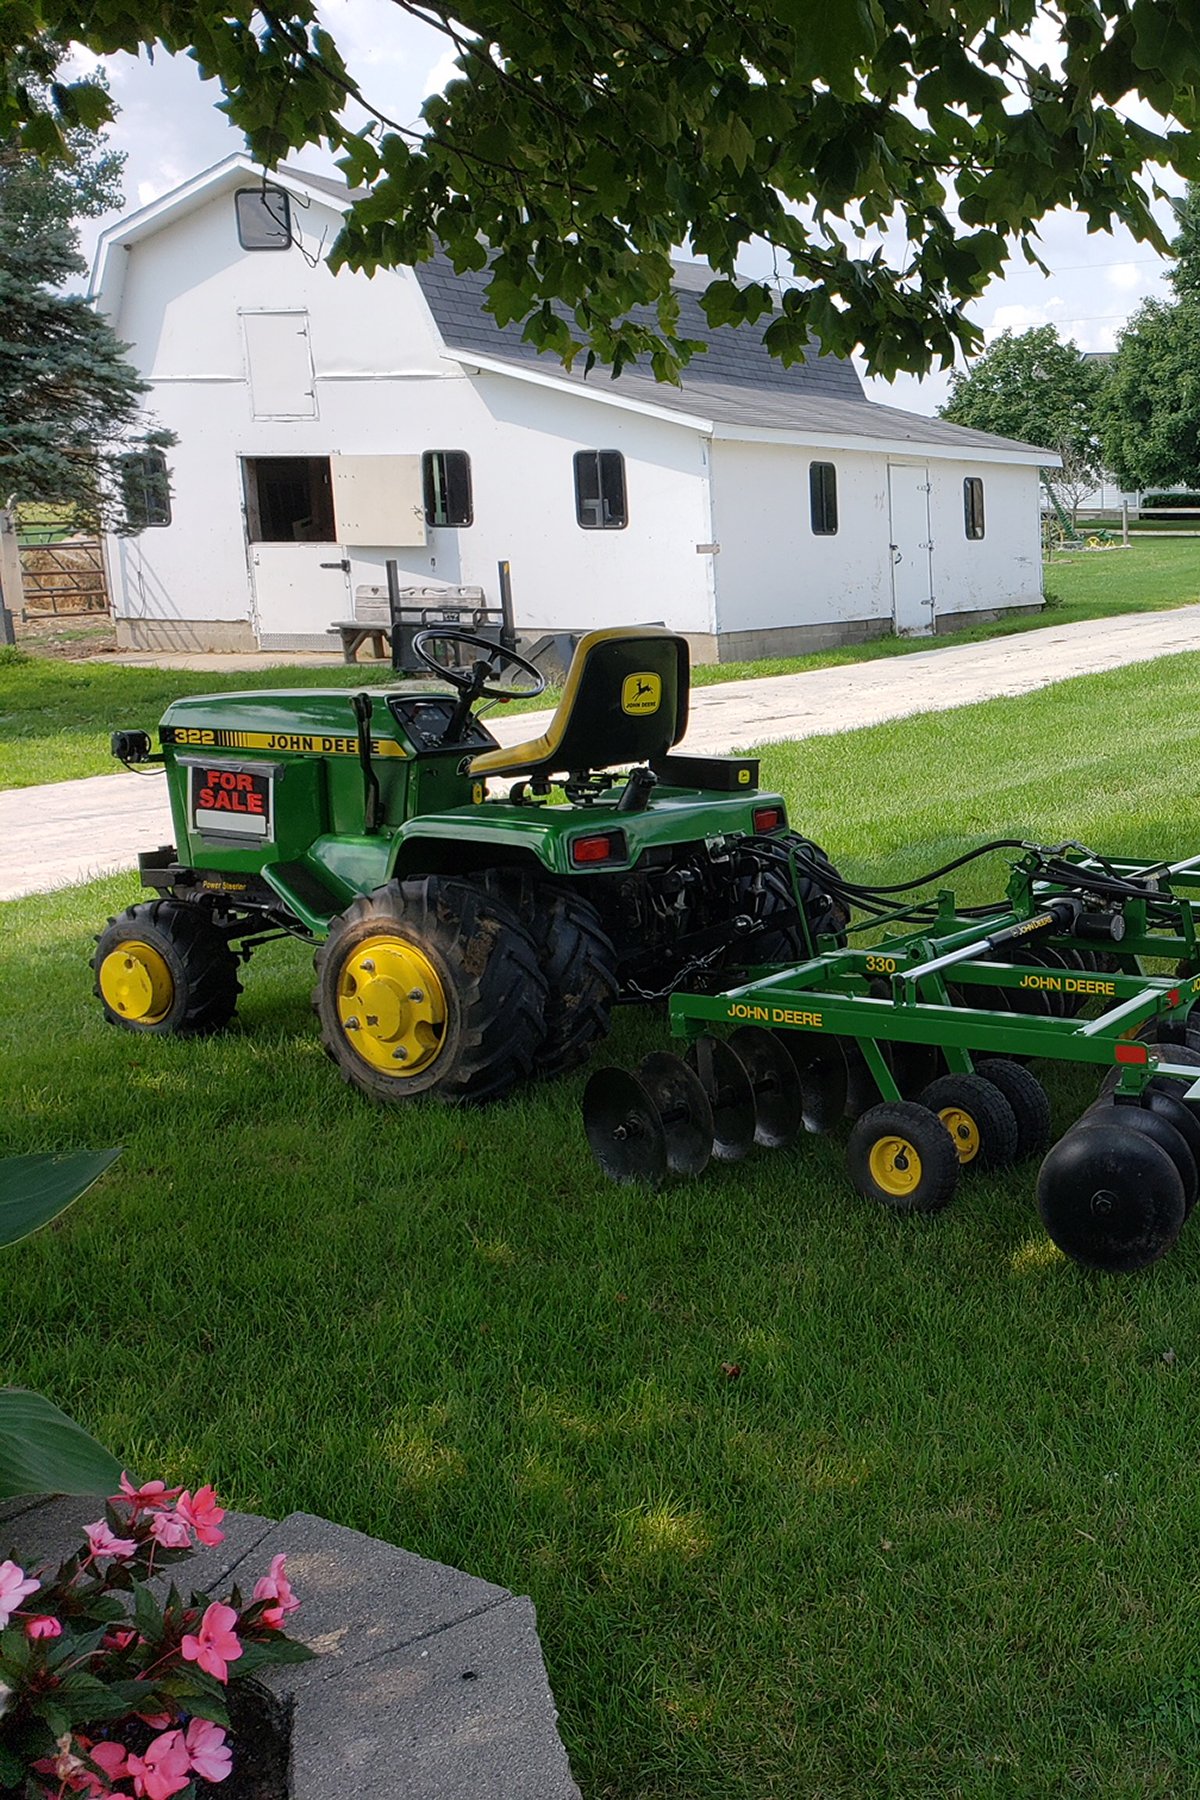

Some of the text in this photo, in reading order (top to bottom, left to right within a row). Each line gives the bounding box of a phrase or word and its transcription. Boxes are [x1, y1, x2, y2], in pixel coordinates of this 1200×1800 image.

[174, 728, 215, 745] 322
[267, 735, 380, 754] JOHN DEEE
[207, 771, 253, 791] FOR
[199, 788, 263, 813] SALE
[202, 880, 221, 889] Power
[866, 955, 896, 973] 330
[1020, 975, 1115, 995] JOHN DEERE
[727, 1003, 823, 1027] JOHN DEERE
